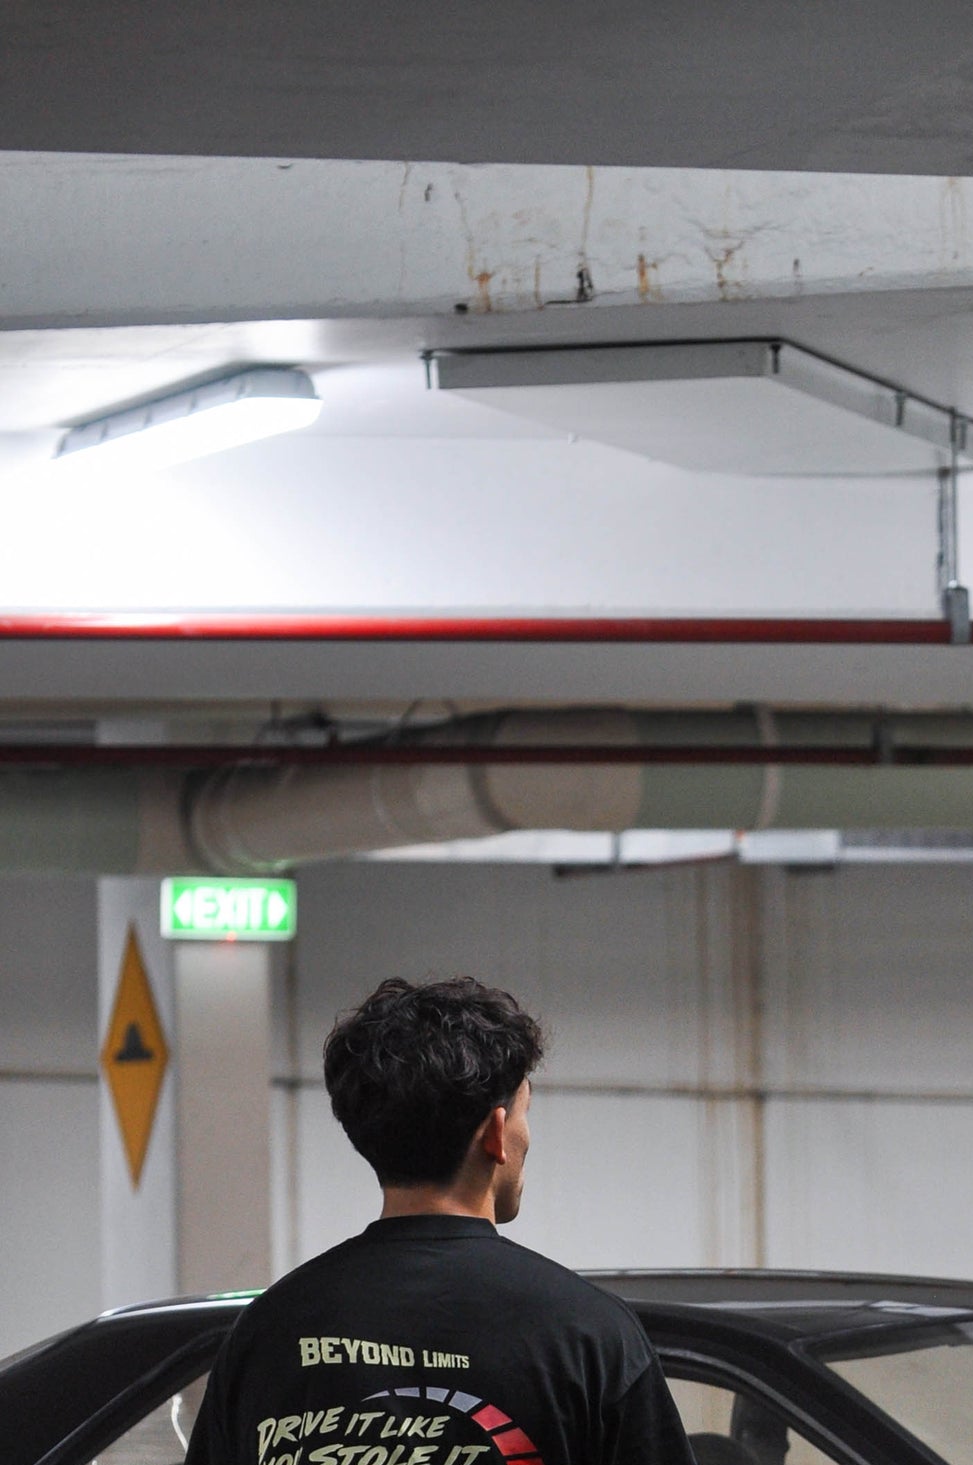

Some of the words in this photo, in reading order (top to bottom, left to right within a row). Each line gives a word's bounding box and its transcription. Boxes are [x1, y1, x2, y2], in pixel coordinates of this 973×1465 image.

[193, 886, 267, 929] EXIT
[299, 1337, 415, 1367] BEYOND
[423, 1350, 470, 1369] LIMITS
[344, 1411, 386, 1437] IT
[380, 1415, 451, 1438] LIKE
